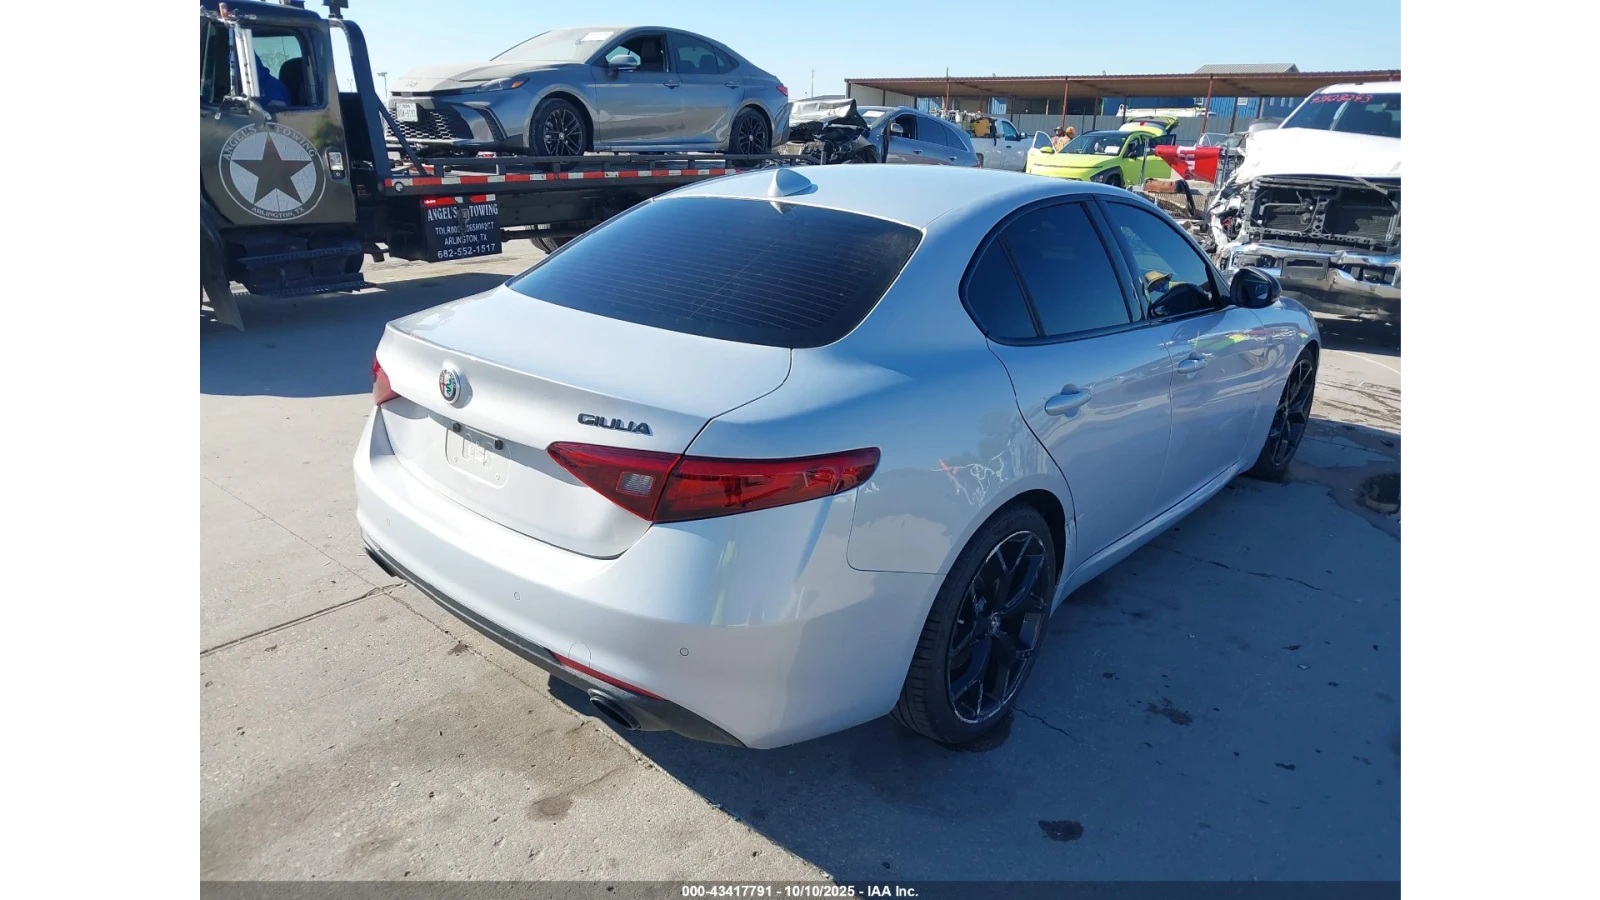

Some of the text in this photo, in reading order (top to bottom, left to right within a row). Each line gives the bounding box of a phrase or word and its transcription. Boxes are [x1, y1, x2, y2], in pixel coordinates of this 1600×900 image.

[222, 125, 318, 161] ANGEL'S TOWING
[295, 206, 305, 214] TX
[428, 204, 499, 221] ANGEL'S TOWING
[480, 233, 488, 241] TX
[437, 243, 496, 258] 682-552-1517
[577, 413, 652, 436] GIULIA
